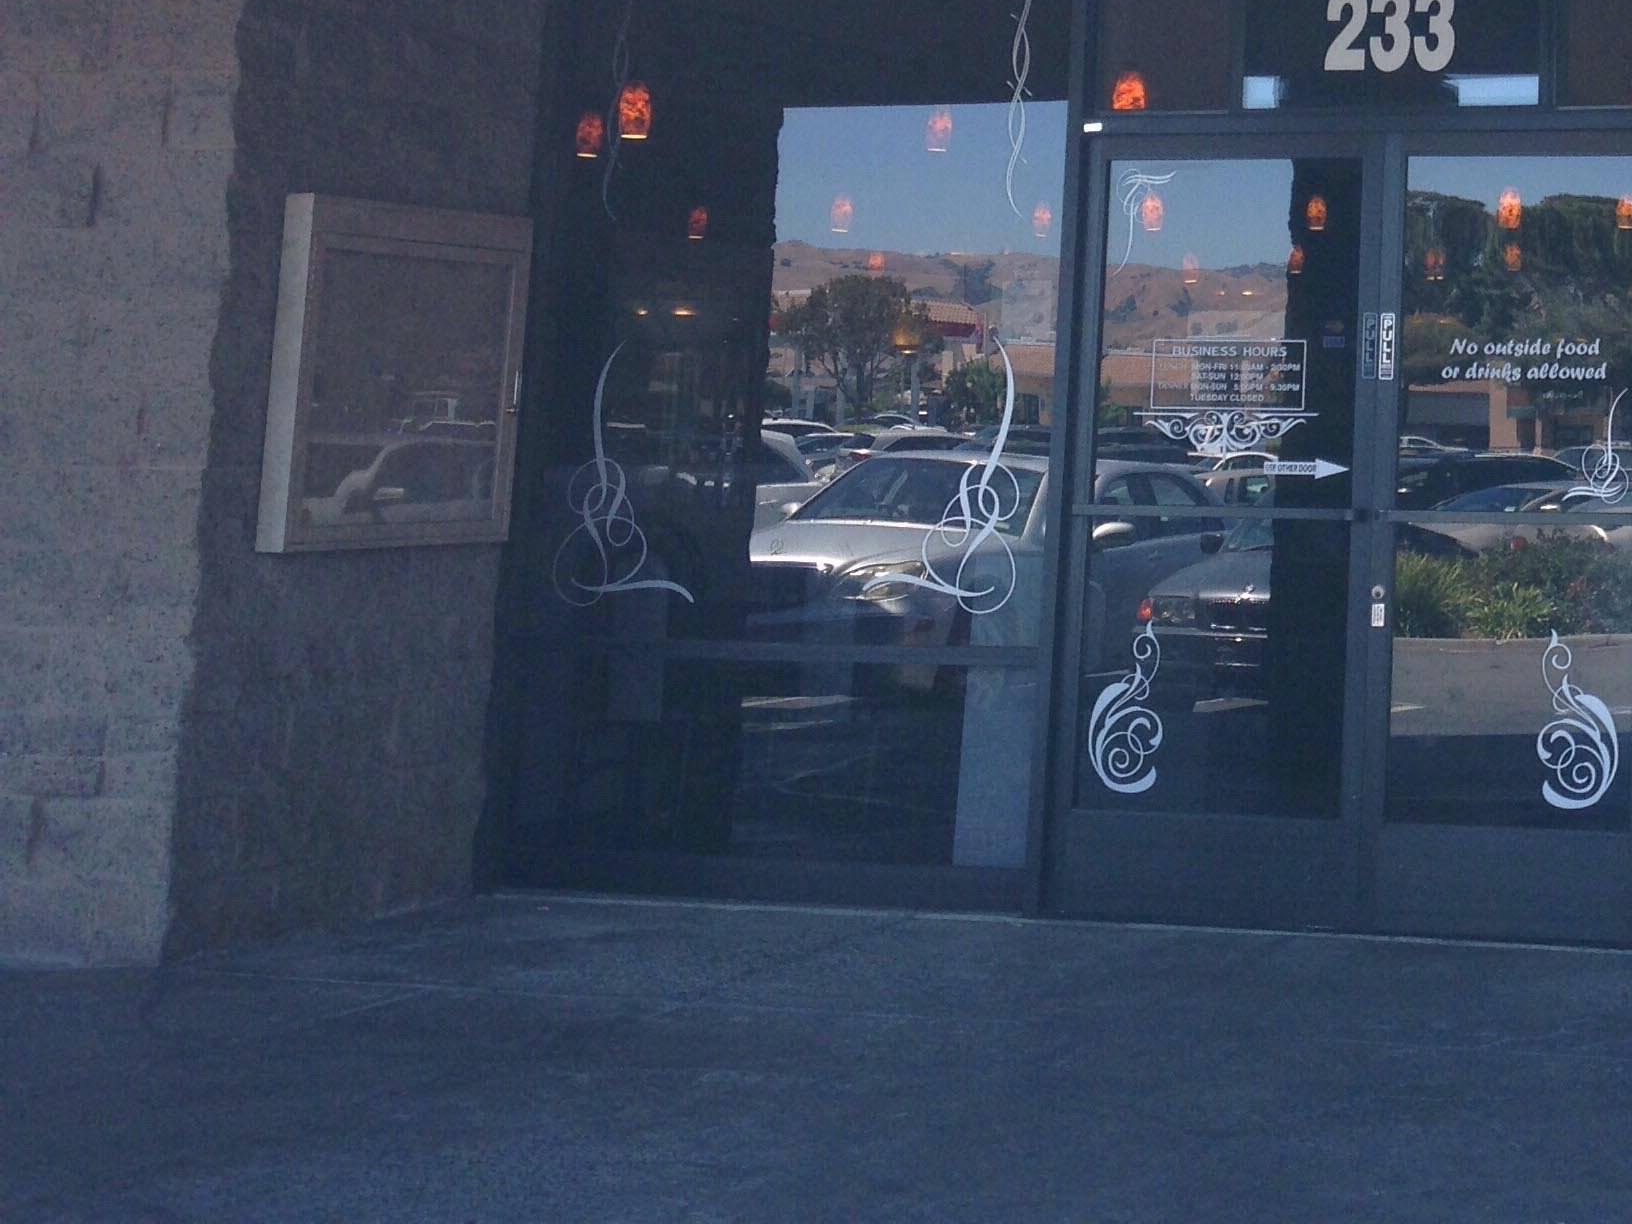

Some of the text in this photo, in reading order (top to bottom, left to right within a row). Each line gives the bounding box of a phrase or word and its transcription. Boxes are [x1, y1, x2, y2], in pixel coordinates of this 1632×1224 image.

[1382, 319, 1393, 363] PULL
[1450, 338, 1601, 359] No outside food
[1172, 345, 1288, 358] BUSINESS HOURS
[1441, 362, 1606, 382] or drinks allowed
[1190, 392, 1265, 402] TUESDAY CLOSED
